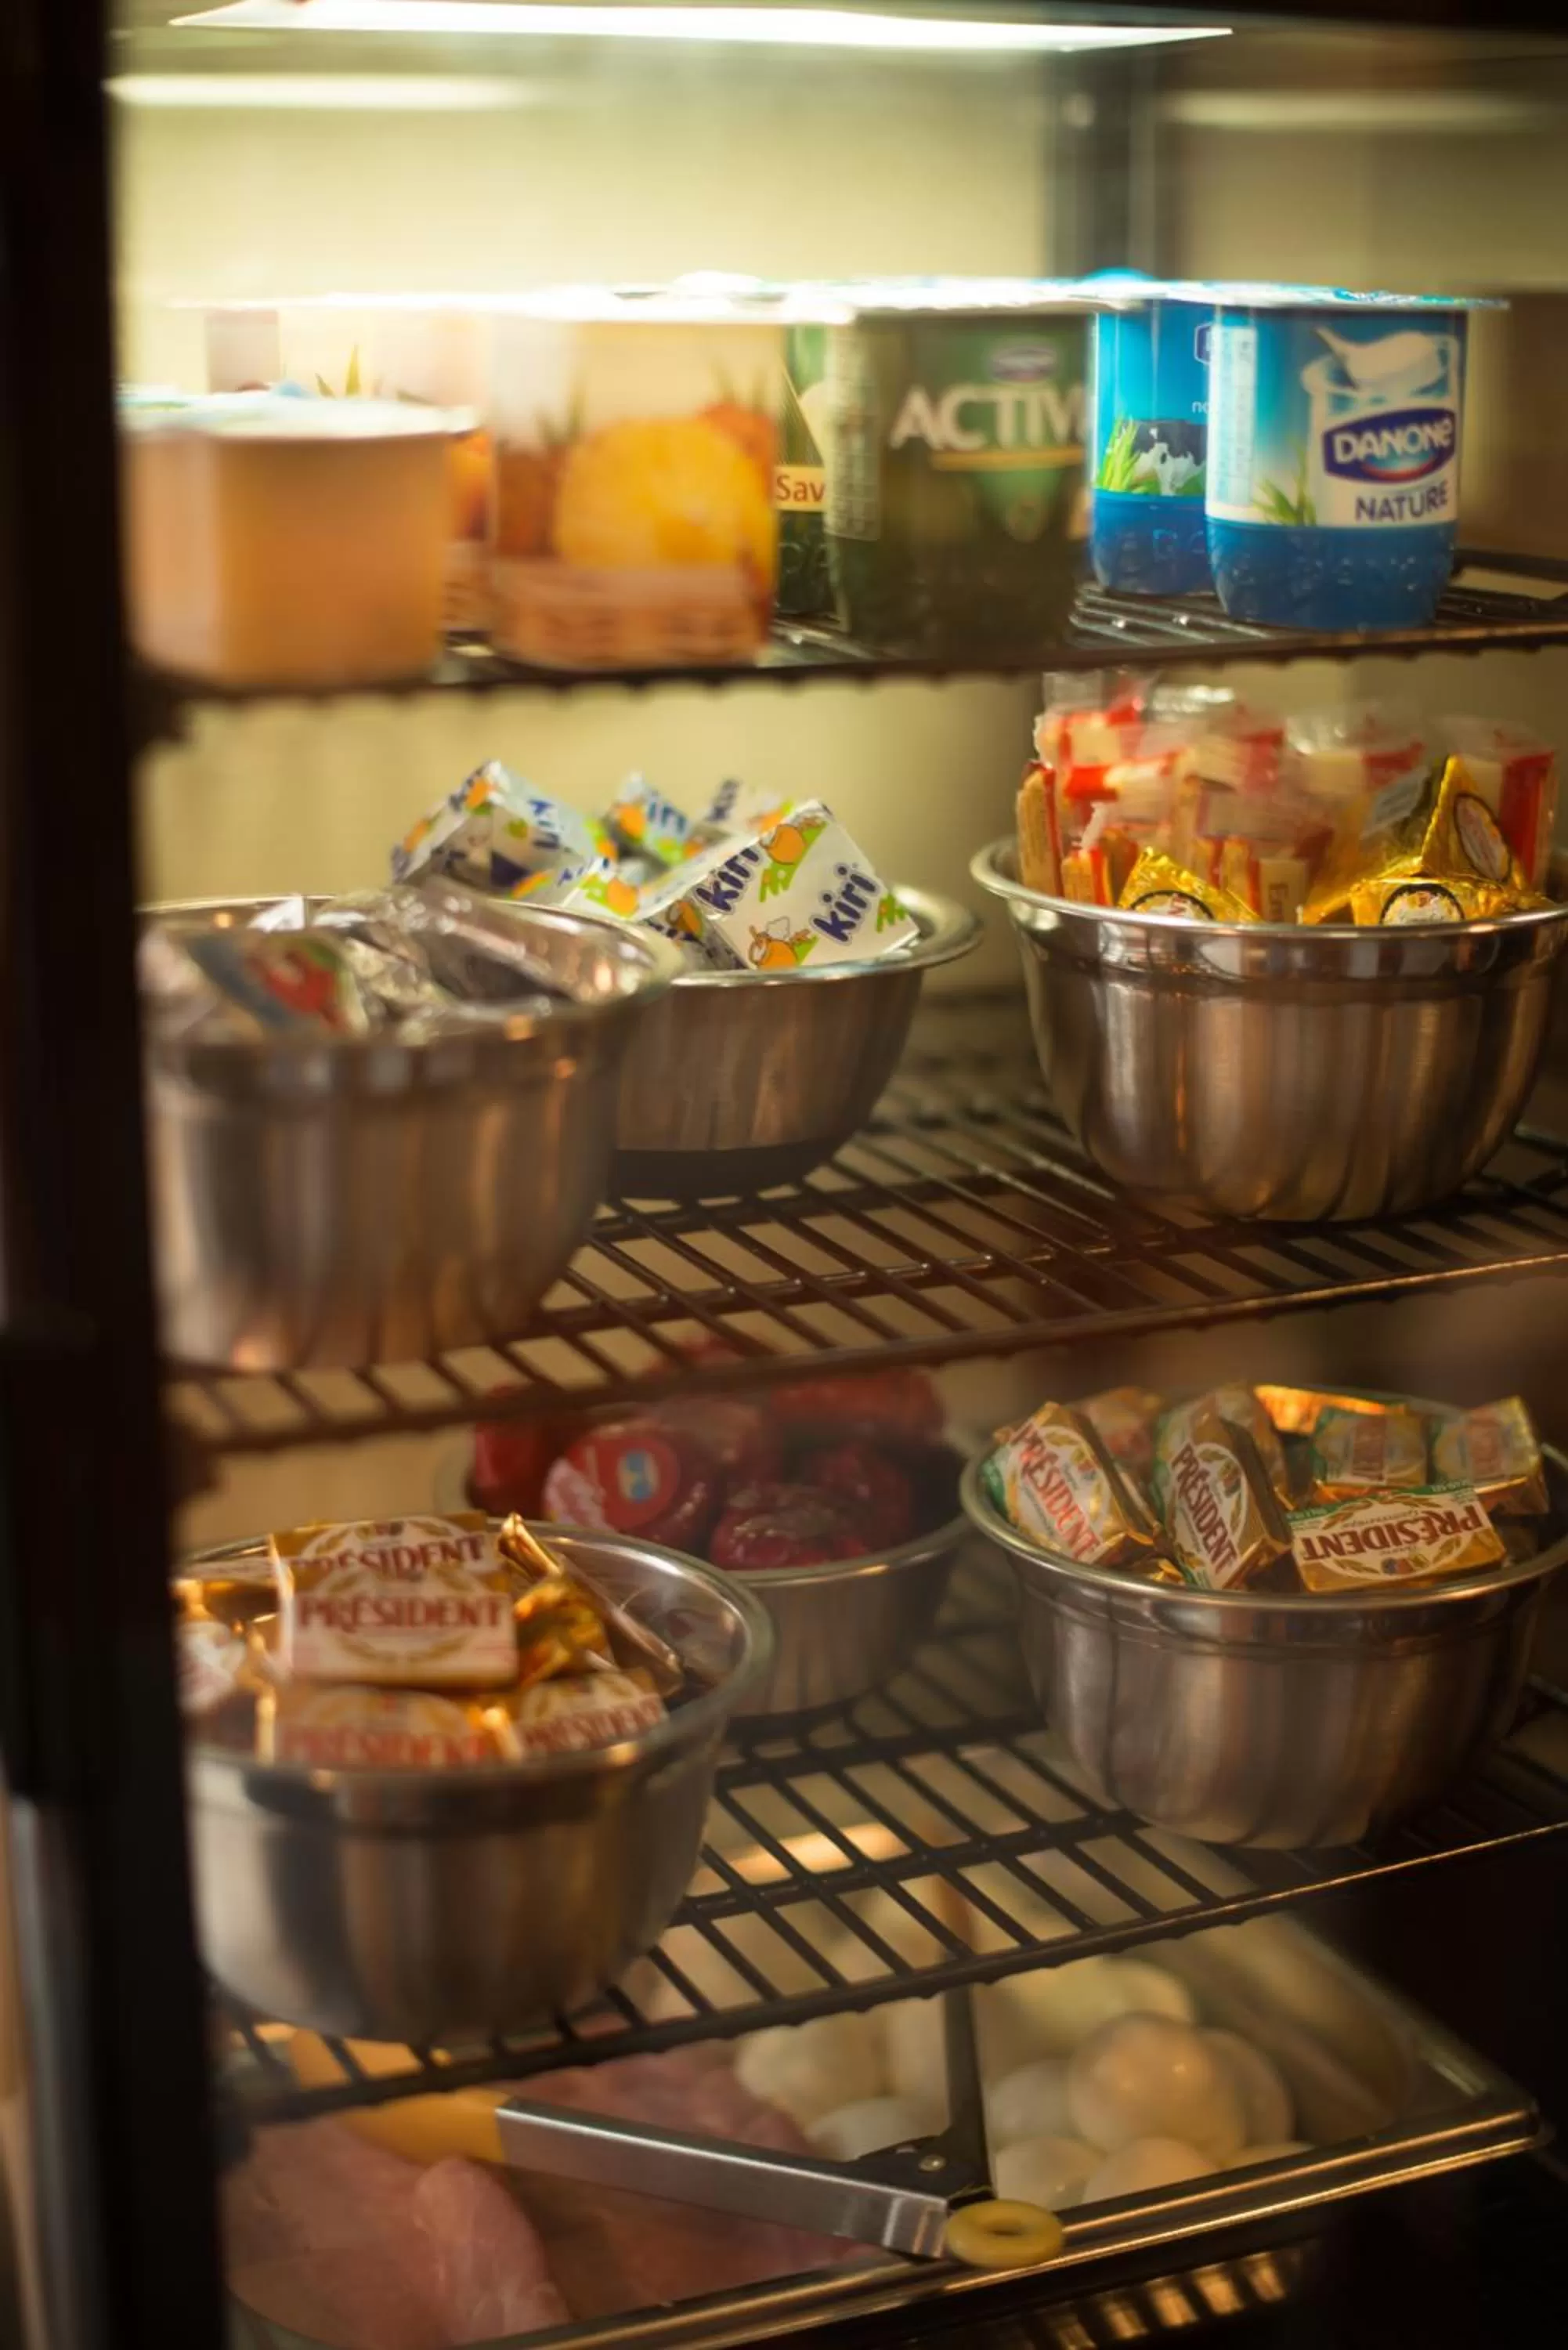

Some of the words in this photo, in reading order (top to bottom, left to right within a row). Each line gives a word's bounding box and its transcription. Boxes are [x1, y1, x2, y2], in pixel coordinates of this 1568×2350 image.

[1334, 418, 1452, 465] DANONE
[1355, 480, 1448, 523] NATURE
[695, 846, 761, 913] kiri
[811, 865, 877, 942] kiri
[1009, 1422, 1100, 1559] PRÉSIDENT
[1171, 1442, 1239, 1575] PRÉSIDENT
[1299, 1504, 1483, 1561] PRÉSIDENT
